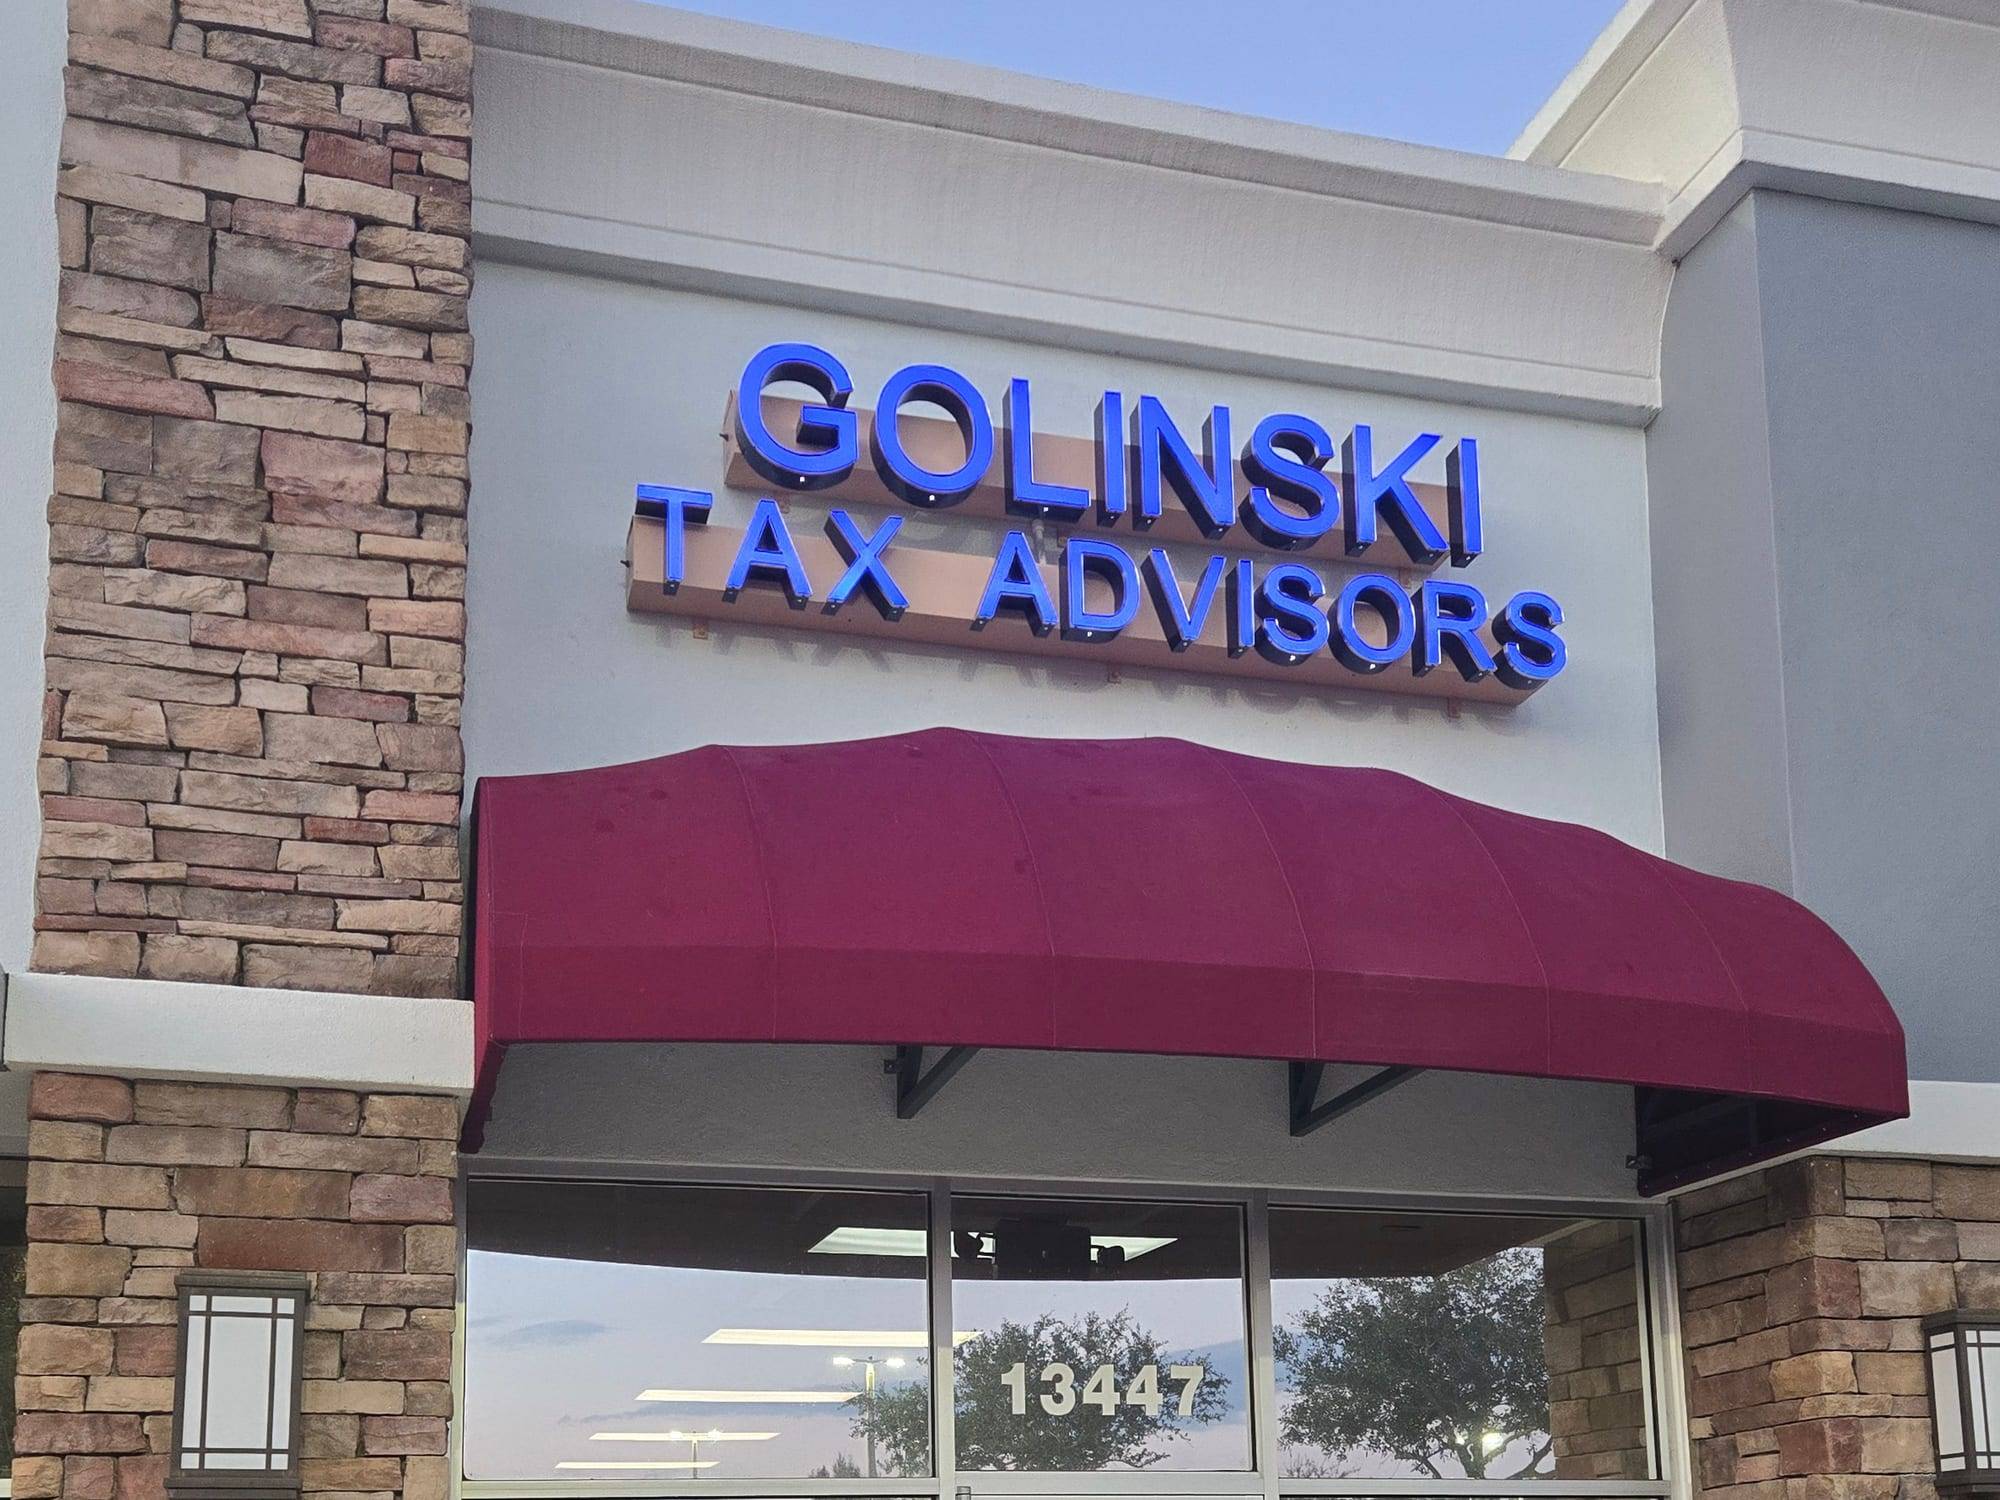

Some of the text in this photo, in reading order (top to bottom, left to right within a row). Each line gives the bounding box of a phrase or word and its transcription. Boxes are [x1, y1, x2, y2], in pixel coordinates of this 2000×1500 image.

[737, 342, 1485, 560] GOLINSKI
[636, 483, 1568, 682] TAX ADVISORS
[1000, 1361, 1204, 1417] 13447
